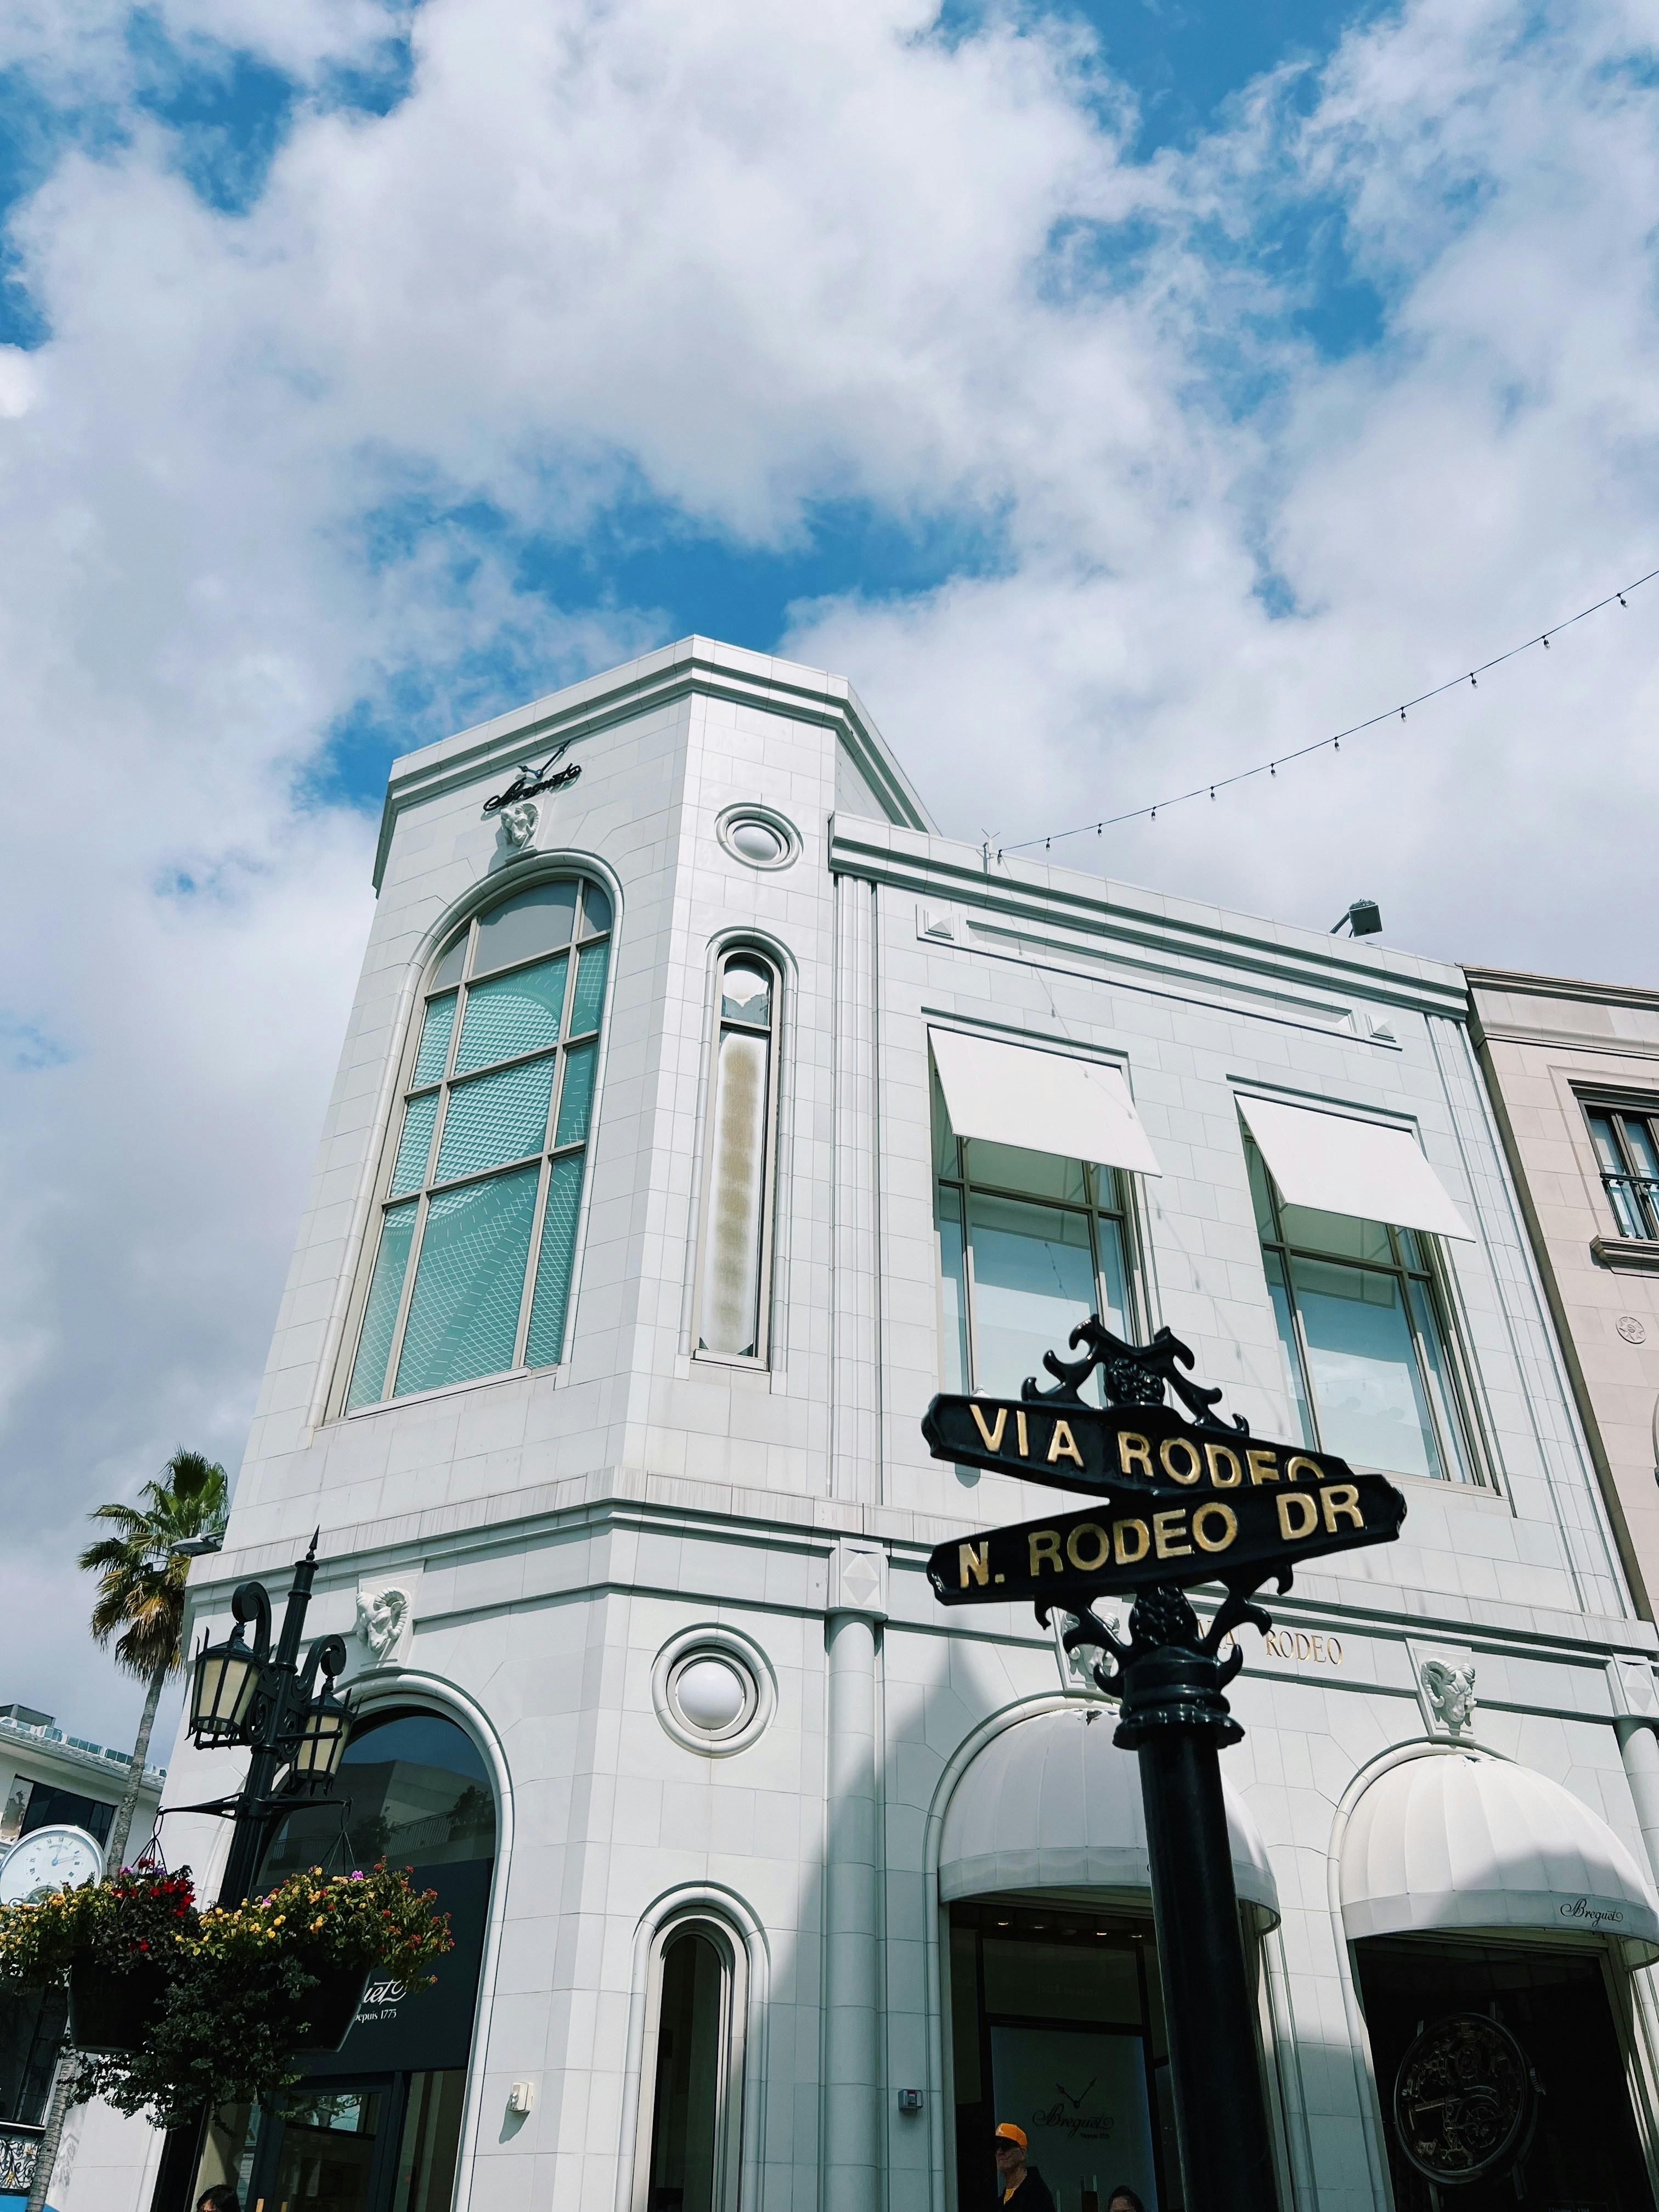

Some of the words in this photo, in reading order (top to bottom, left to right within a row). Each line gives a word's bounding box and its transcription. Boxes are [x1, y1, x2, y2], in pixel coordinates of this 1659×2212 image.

[970, 1404, 1085, 1468] VIA
[959, 1542, 1005, 1589] N.
[1029, 1502, 1238, 1577] RODEO
[1277, 1484, 1364, 1541] DR
[1266, 1629, 1342, 1666] RODEO
[1560, 1898, 1623, 1927] Breguet
[380, 2008, 397, 2019] 1775
[1032, 2103, 1114, 2138] Breguet
